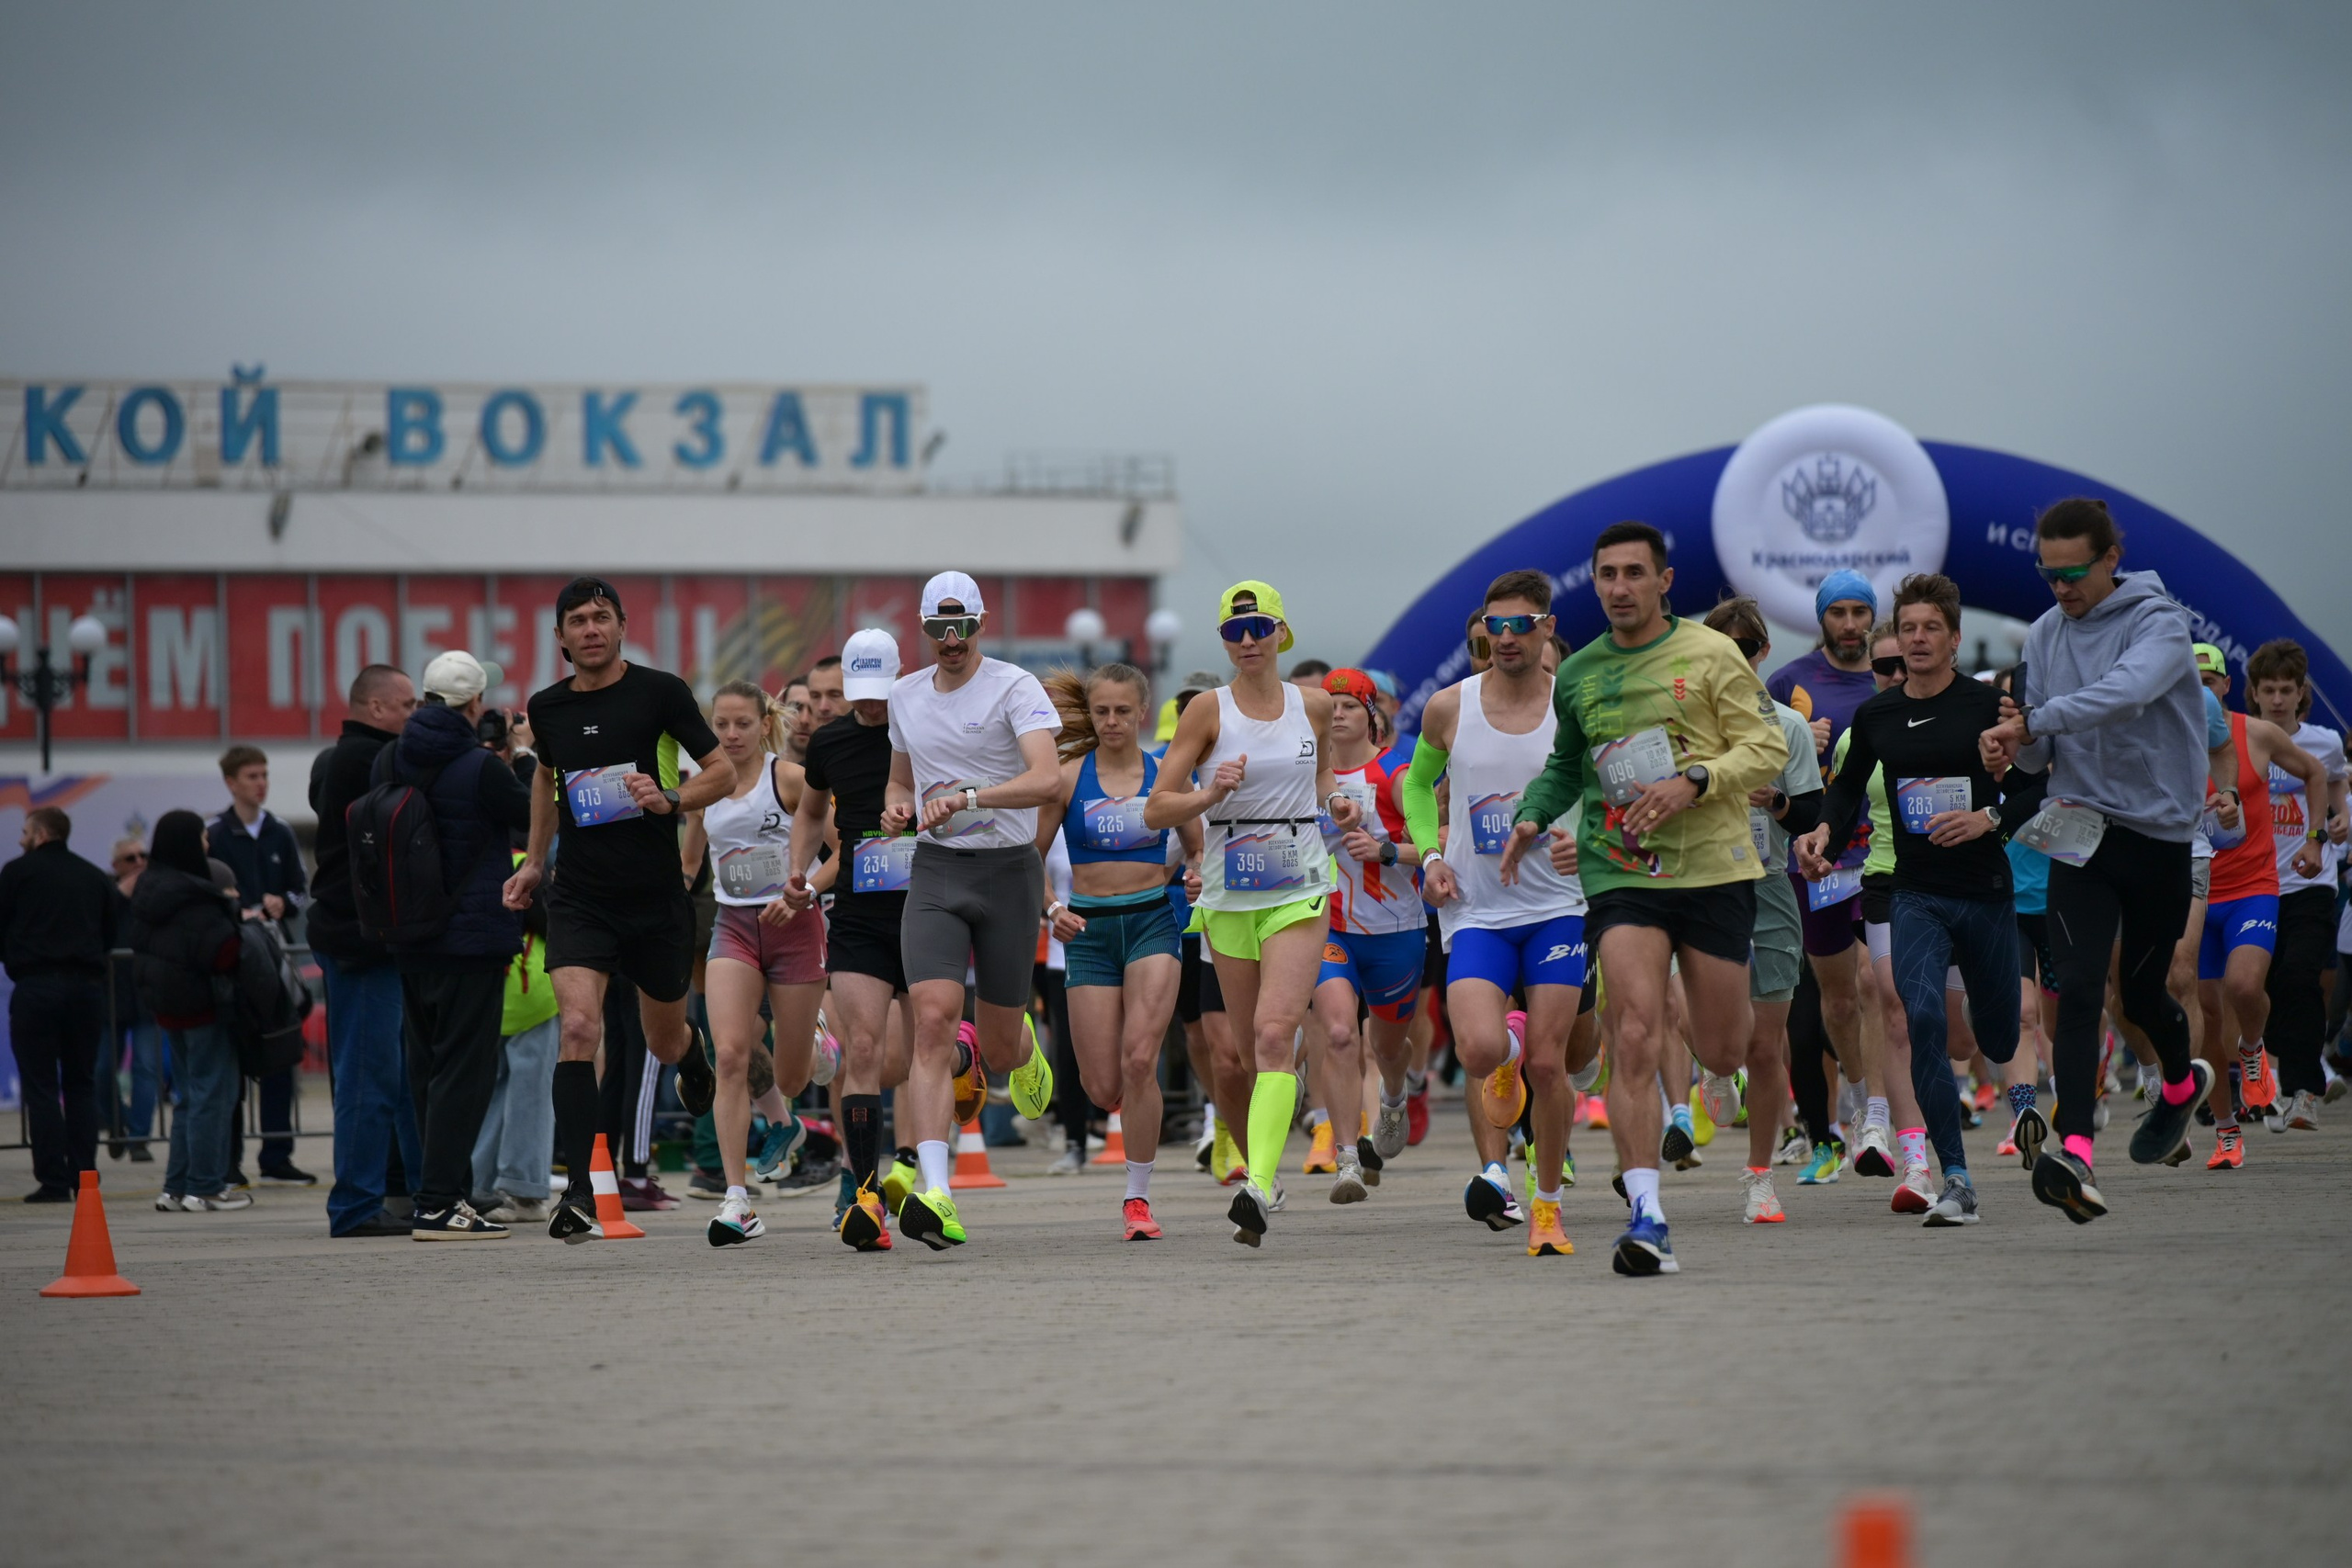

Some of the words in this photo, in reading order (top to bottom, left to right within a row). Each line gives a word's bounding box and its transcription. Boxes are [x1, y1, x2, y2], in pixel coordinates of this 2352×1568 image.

[25, 362, 280, 465] КОЙ
[386, 387, 910, 468] ВОКЗАЛ
[1607, 759, 1636, 784] 096
[578, 787, 602, 807] 413
[1907, 796, 1933, 815] 283
[1950, 794, 1954, 803] 5
[1950, 802, 1966, 811] 2025
[1097, 815, 1125, 834] 225
[1481, 813, 1512, 834] 404
[2032, 810, 2064, 838] 052
[864, 855, 889, 874] 234
[1237, 853, 1265, 872] 395
[1282, 851, 1286, 860] 5
[1282, 858, 1299, 868] 2025
[729, 863, 752, 882] 043
[1819, 875, 1838, 893] 273
